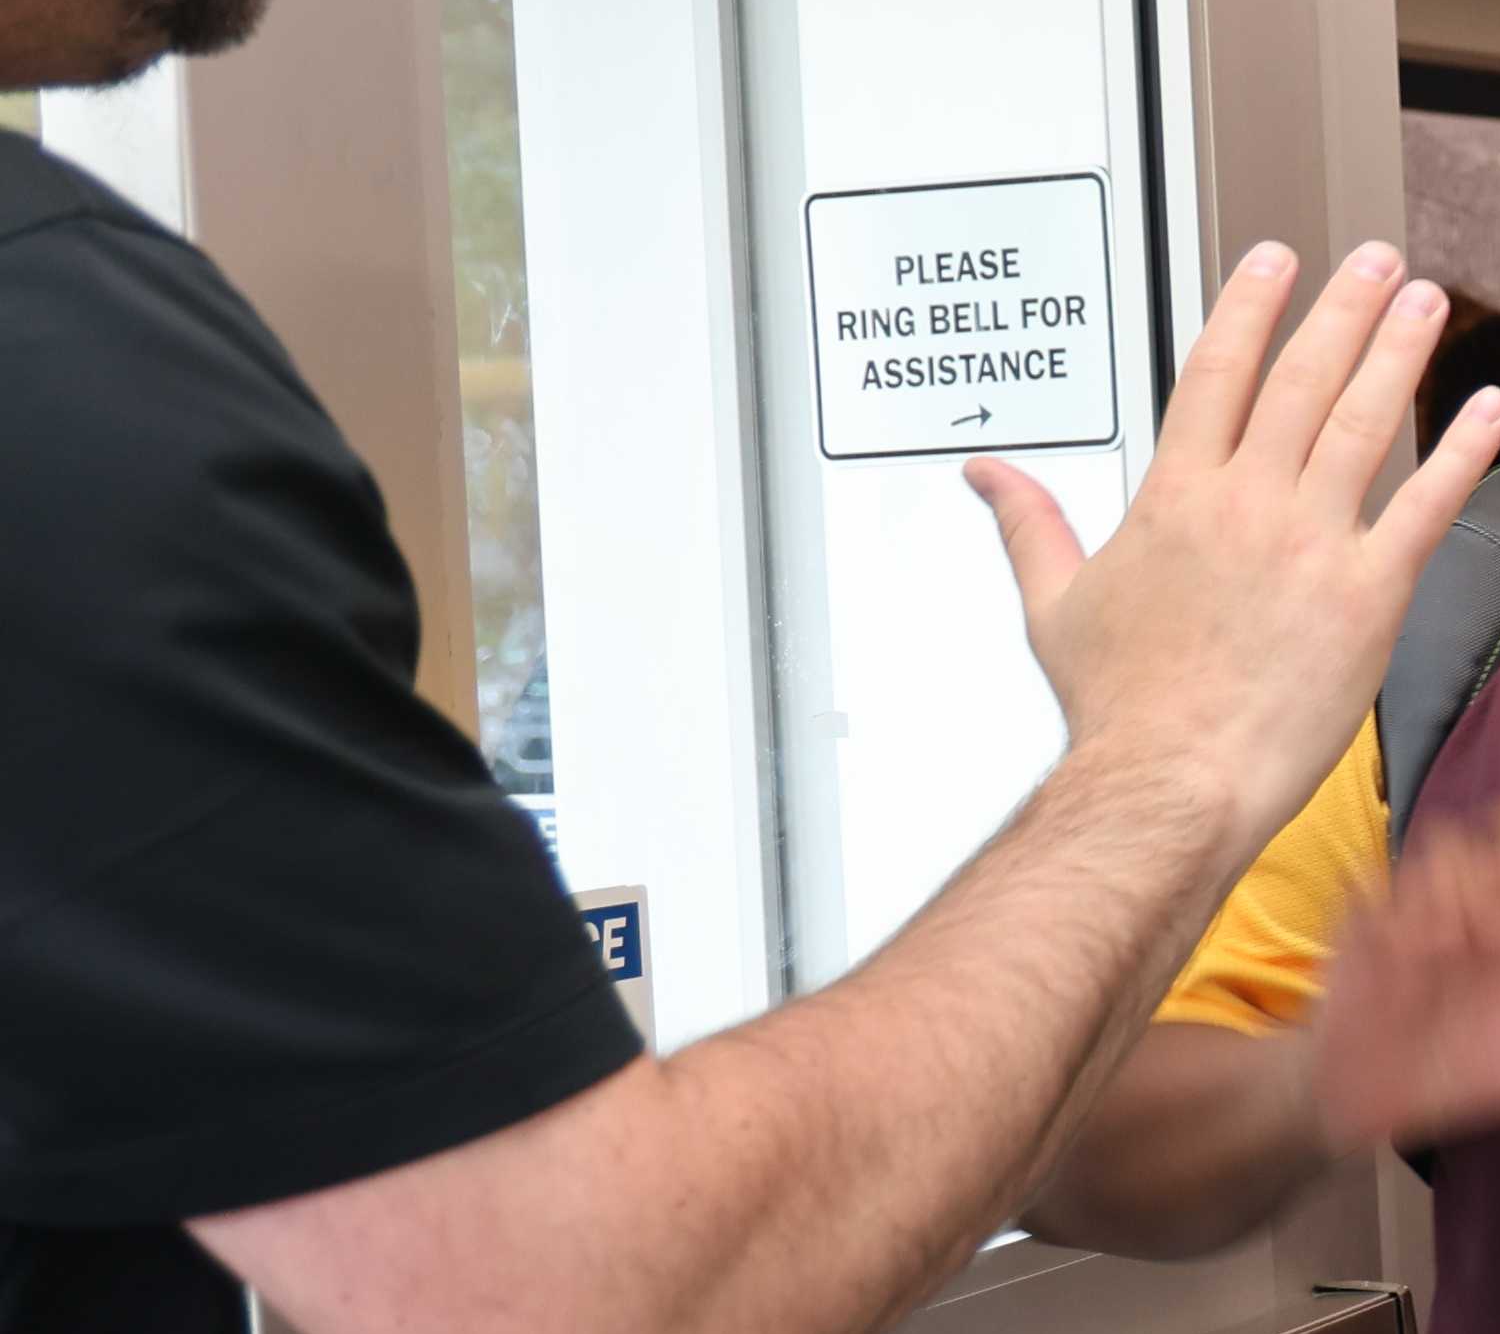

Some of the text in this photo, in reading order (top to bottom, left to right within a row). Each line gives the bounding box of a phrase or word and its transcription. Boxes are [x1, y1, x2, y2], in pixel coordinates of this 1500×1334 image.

[894, 248, 1021, 286] PLEASE
[837, 295, 1087, 341] RING BELL FOR
[861, 348, 1069, 391] ASSISTANCE
[584, 916, 628, 970] E
